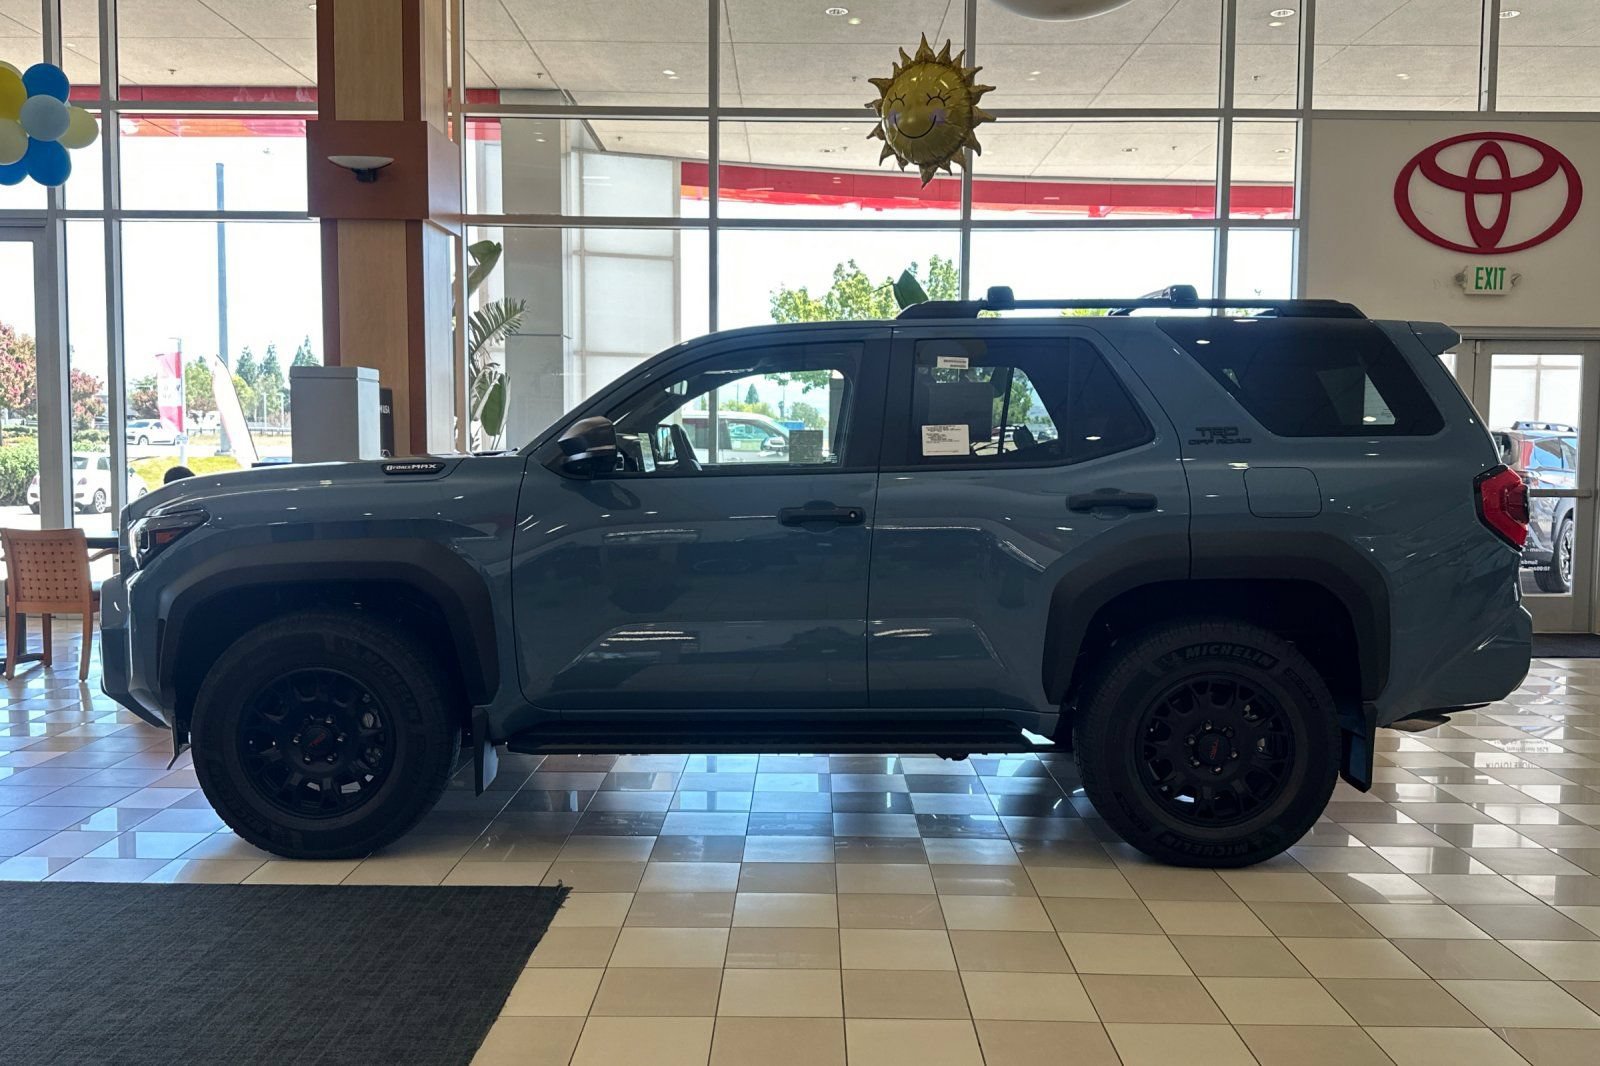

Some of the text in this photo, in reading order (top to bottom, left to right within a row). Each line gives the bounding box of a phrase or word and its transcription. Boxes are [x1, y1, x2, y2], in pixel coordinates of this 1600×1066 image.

[1474, 266, 1506, 290] EXIT
[1195, 426, 1239, 439] TRD
[1216, 437, 1252, 445] ROAD
[1185, 643, 1275, 668] MICHELIN
